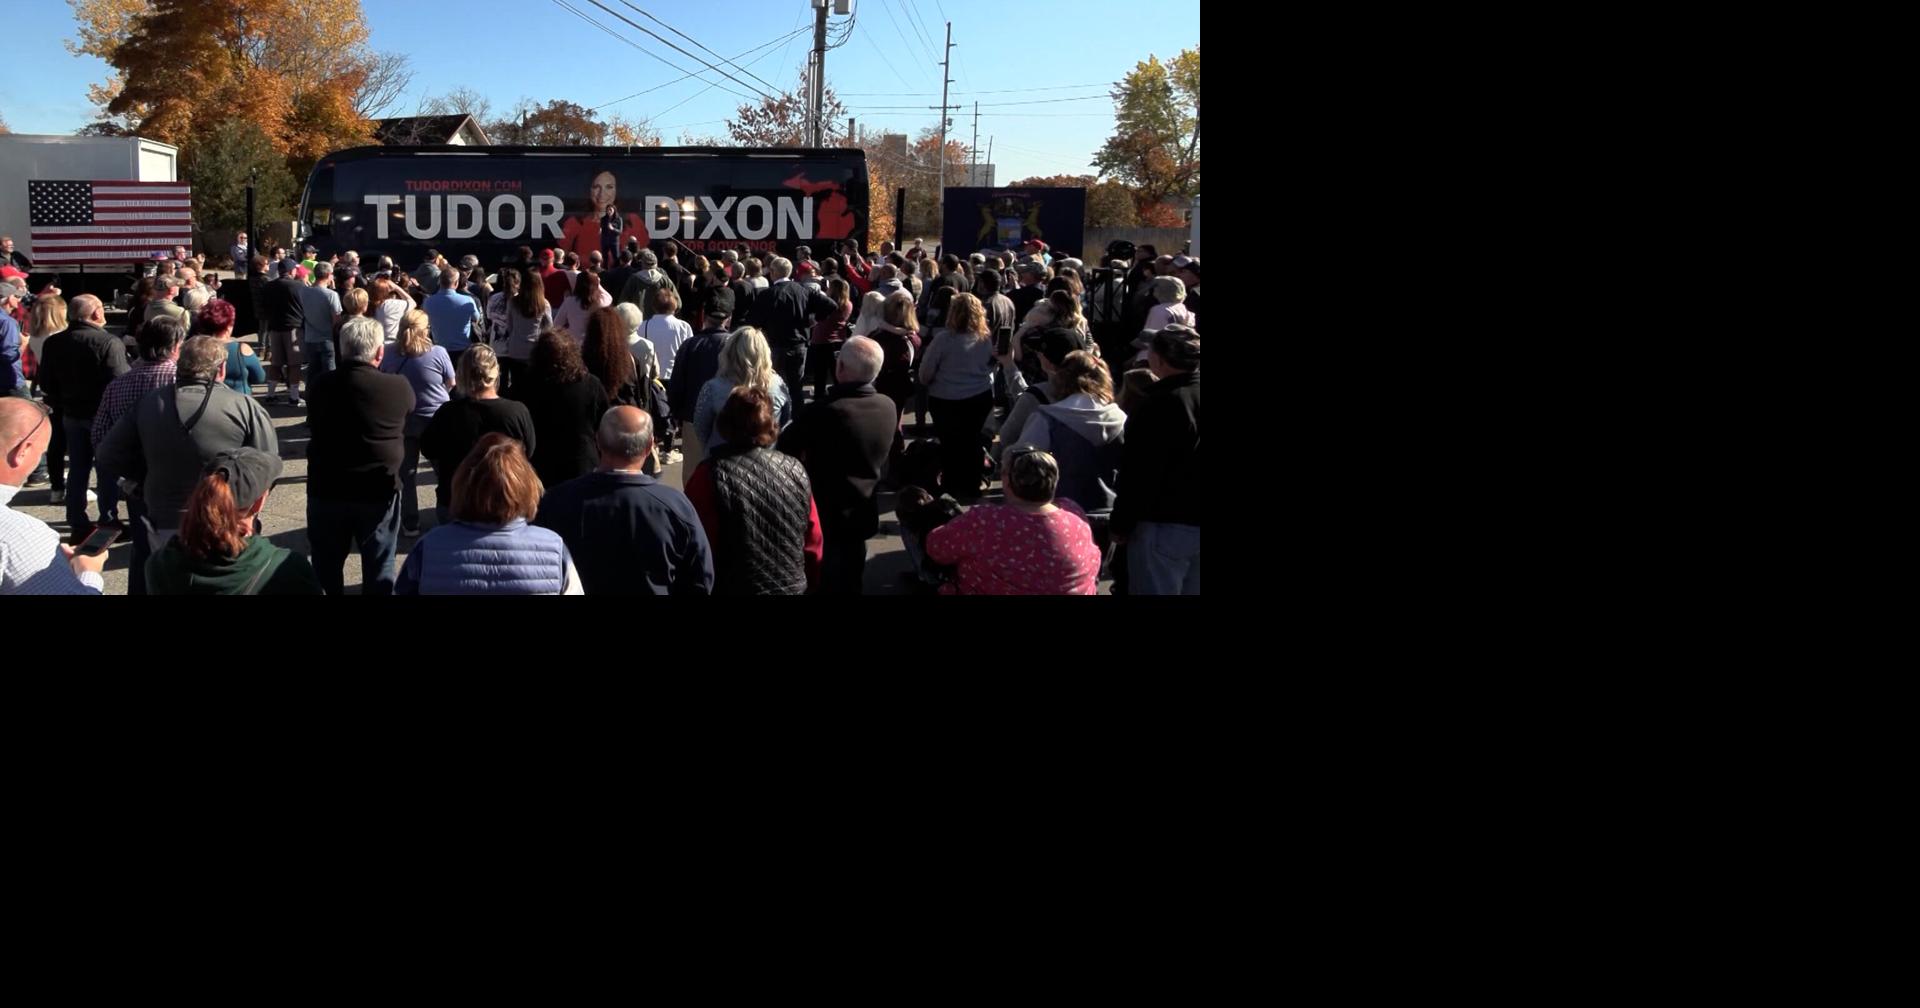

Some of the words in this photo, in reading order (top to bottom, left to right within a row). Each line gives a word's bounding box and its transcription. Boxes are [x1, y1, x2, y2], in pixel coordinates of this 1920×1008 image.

[405, 180, 522, 191] TUDORDIXON.COM
[364, 194, 566, 239] TUDOR
[645, 195, 814, 240] DIXON
[708, 240, 777, 251] GOVNOR
